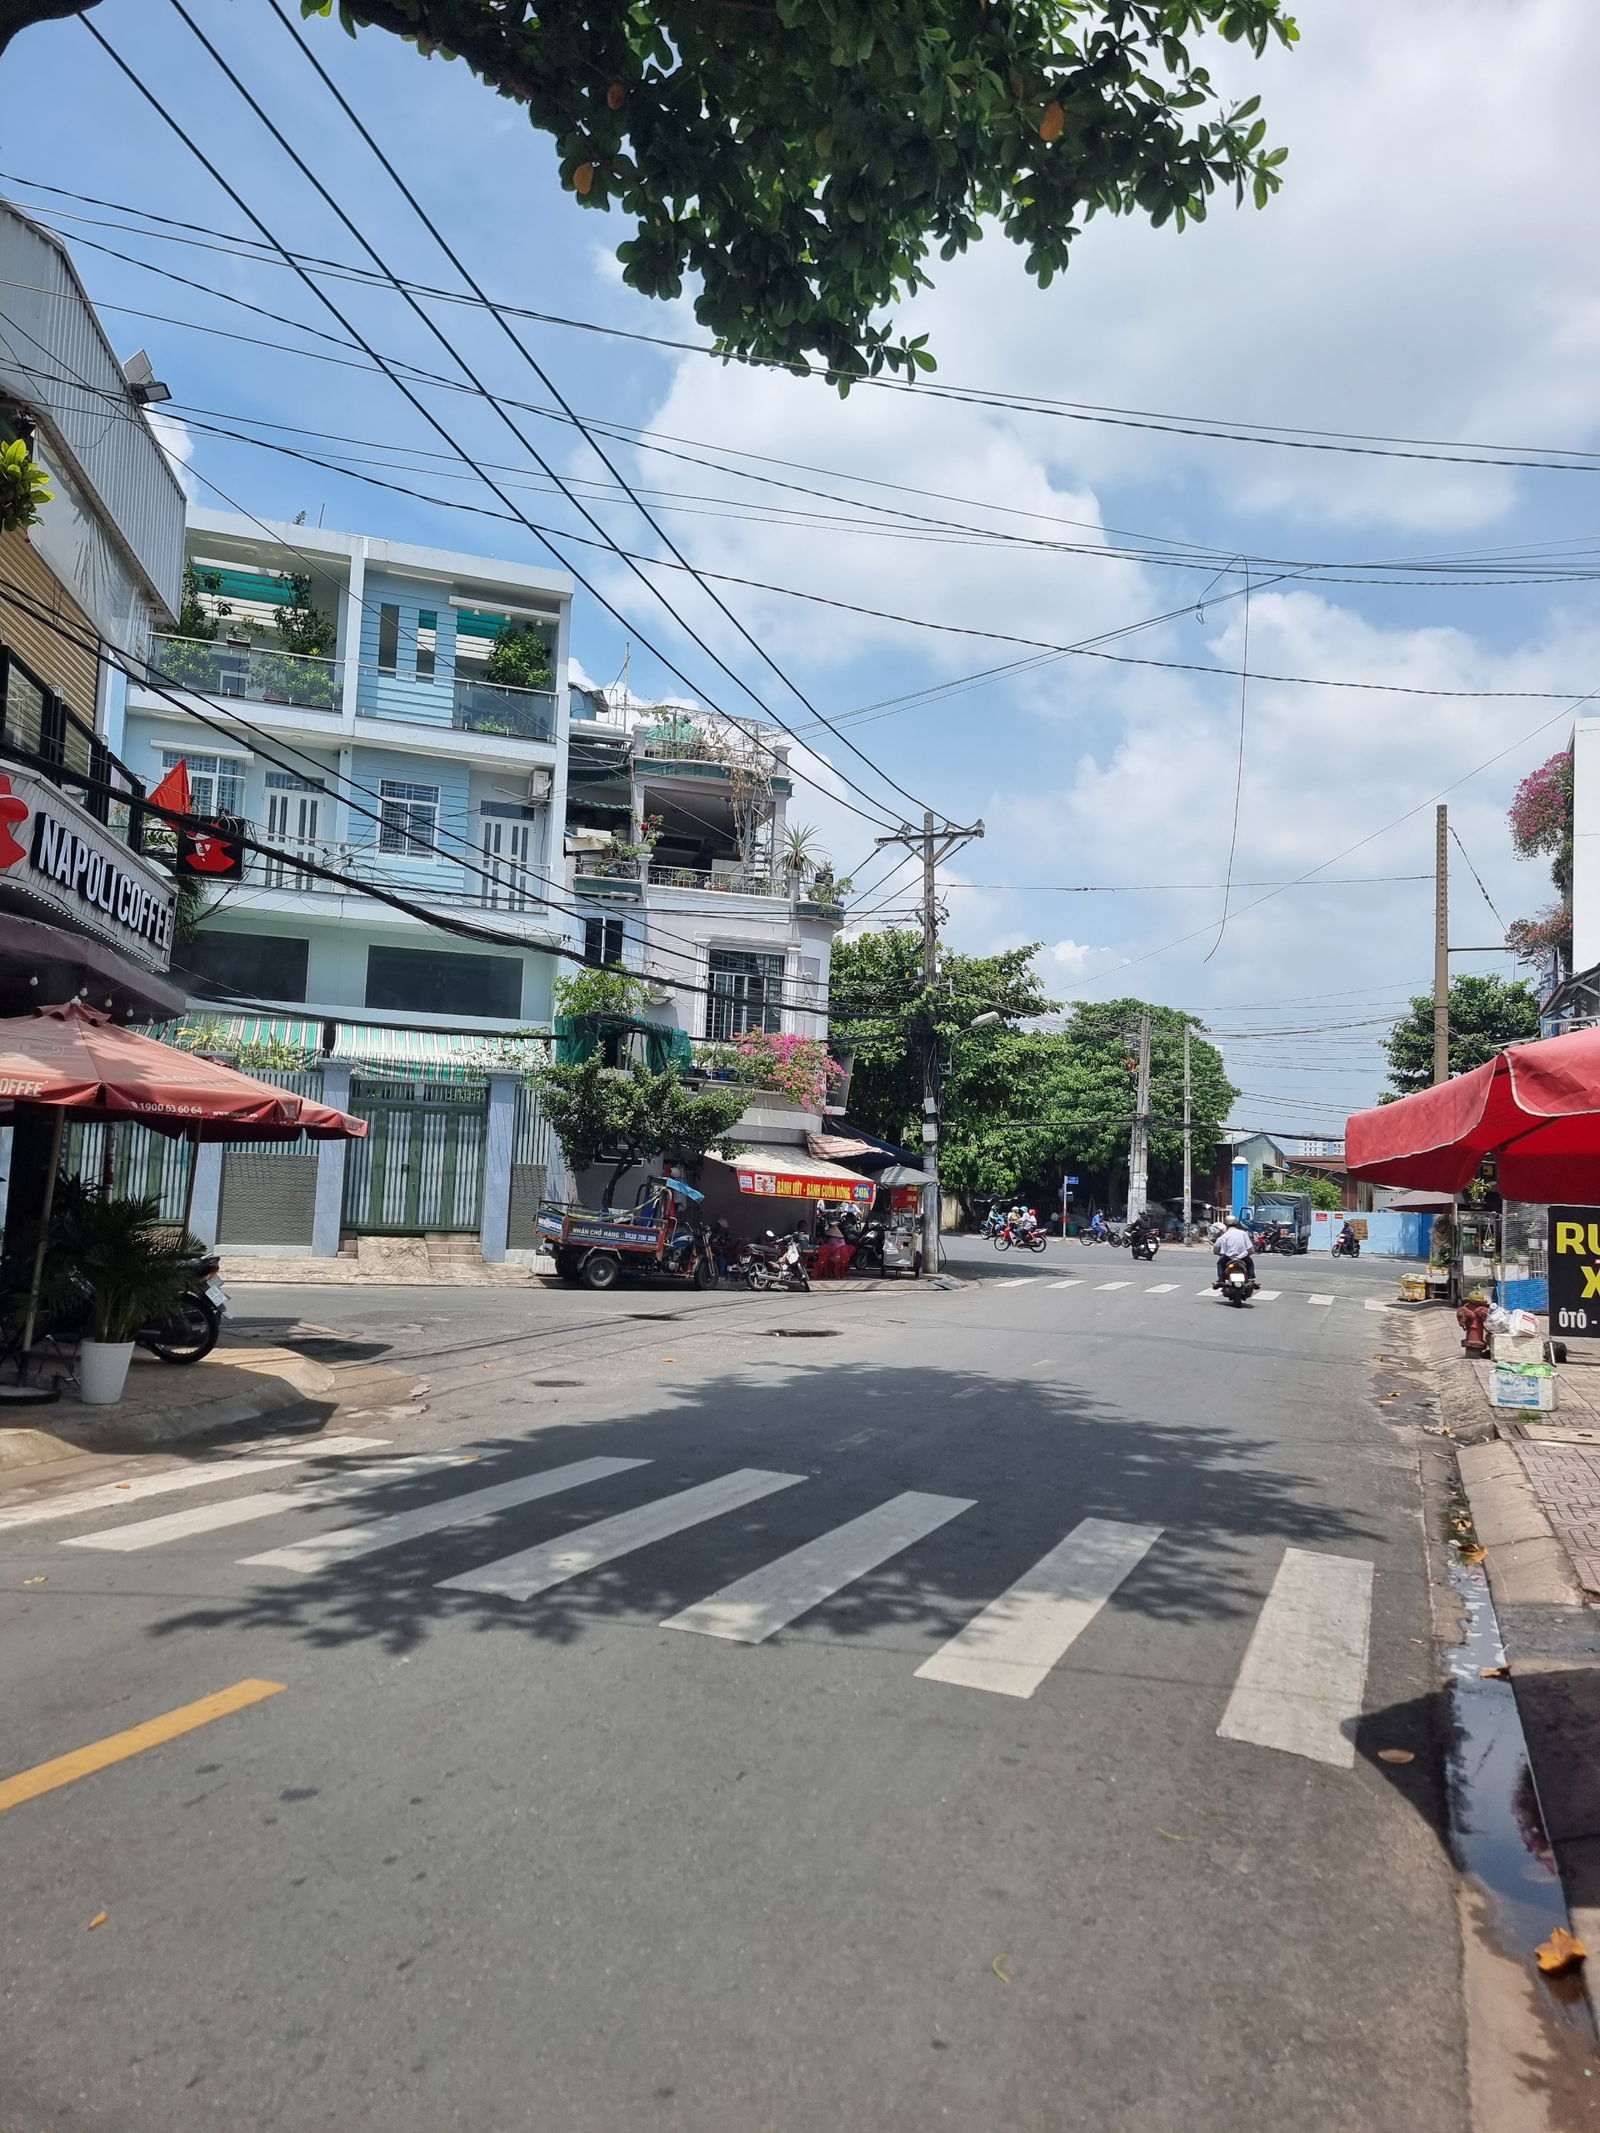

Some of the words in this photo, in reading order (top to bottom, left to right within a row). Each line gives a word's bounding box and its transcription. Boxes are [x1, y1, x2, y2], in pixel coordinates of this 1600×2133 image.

[33, 812, 118, 914] NAPOLI
[116, 873, 174, 951] COFFEE
[139, 1102, 163, 1112] 1900
[165, 1104, 177, 1113] 63
[178, 1105, 189, 1114] 60
[190, 1105, 203, 1115] 64
[572, 1227, 589, 1236] NHẬN
[1558, 1307, 1587, 1329] ÔTÔ
